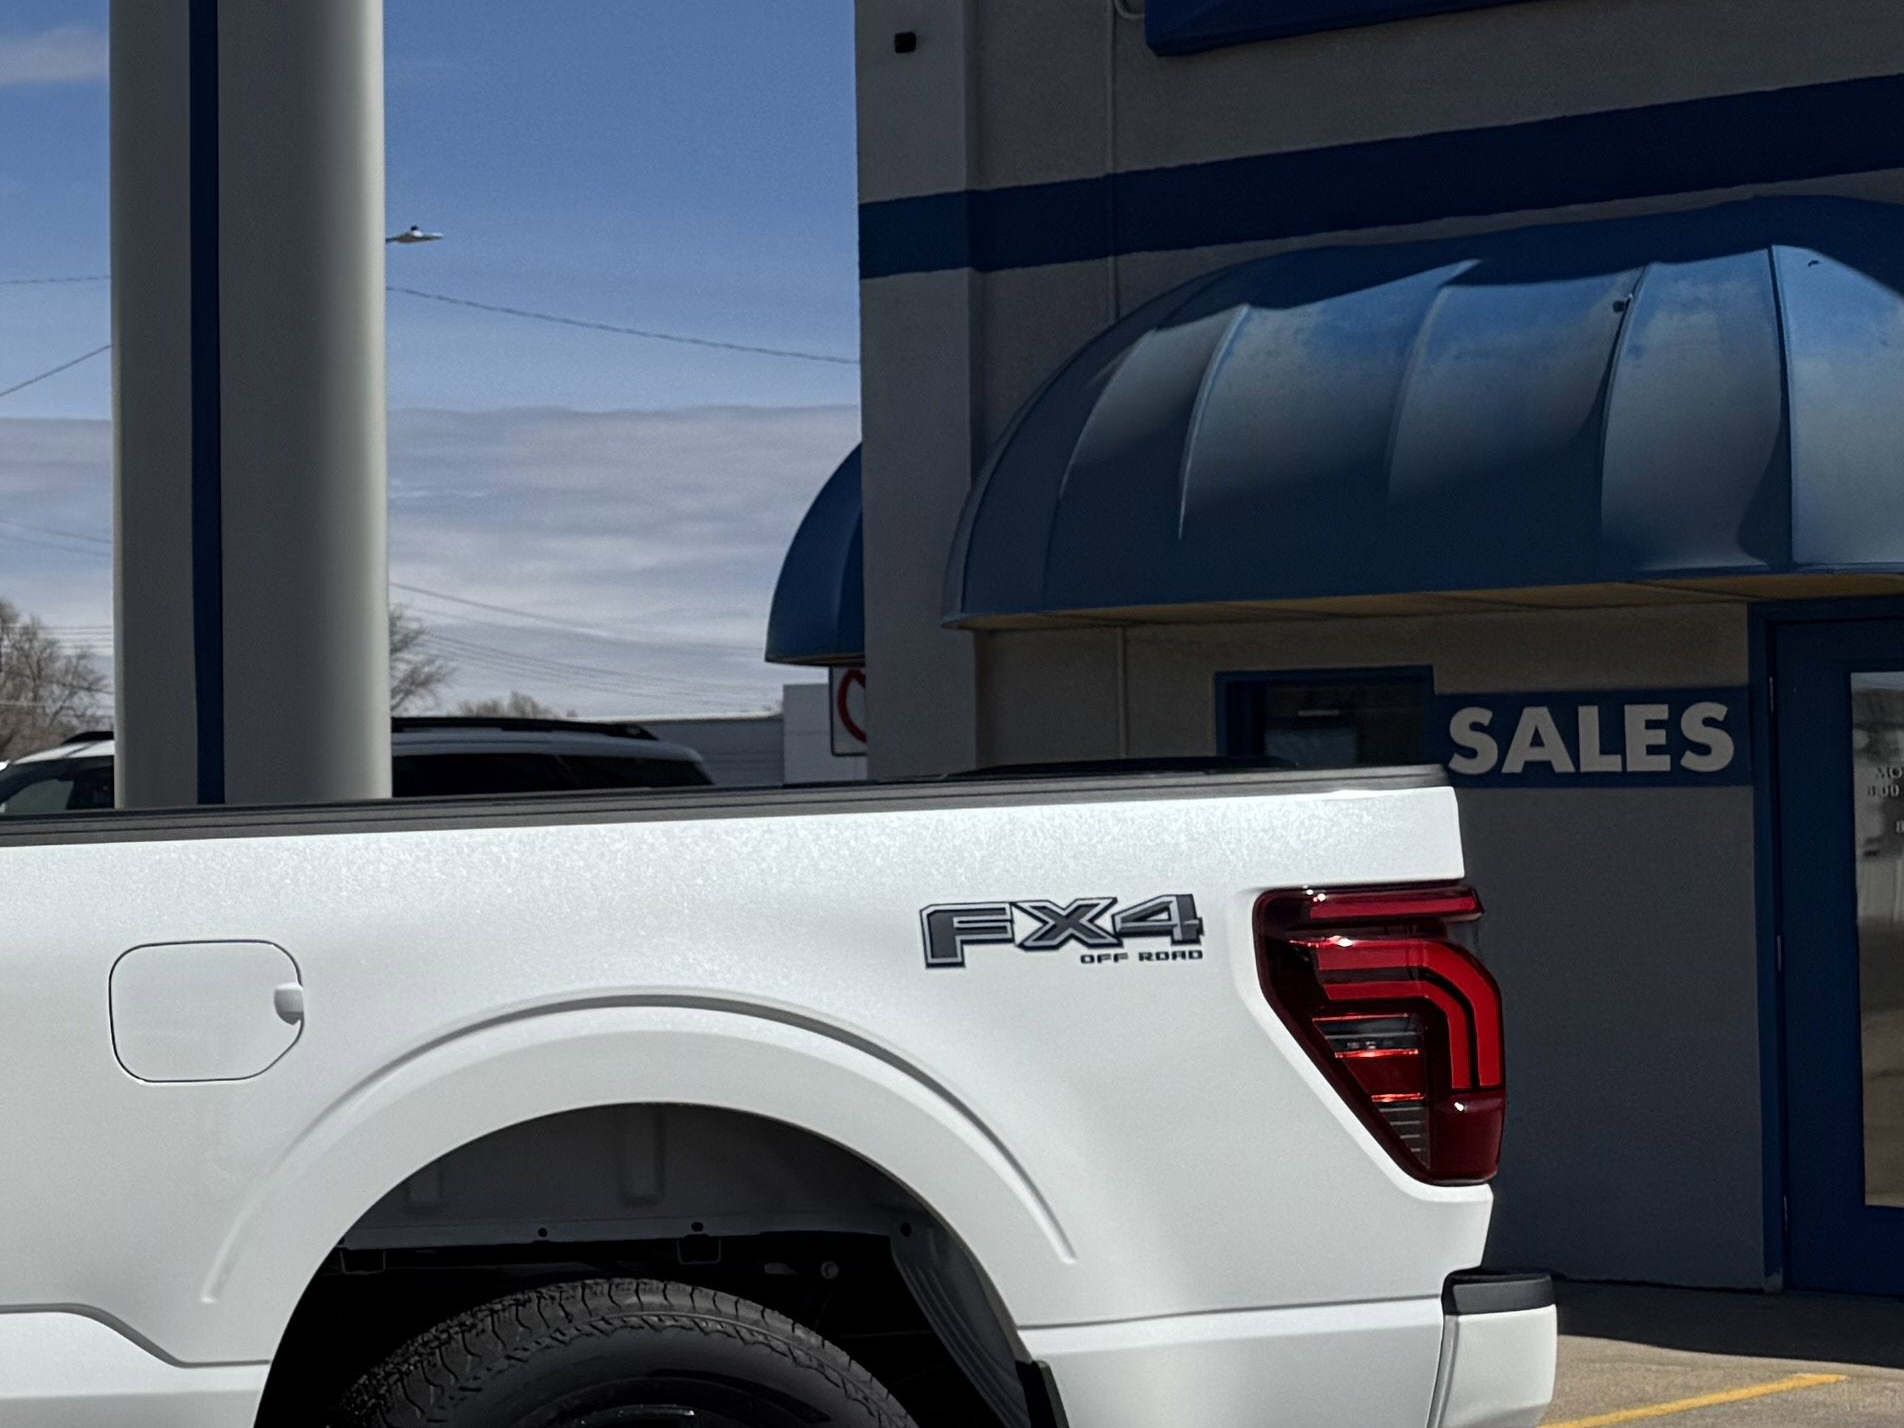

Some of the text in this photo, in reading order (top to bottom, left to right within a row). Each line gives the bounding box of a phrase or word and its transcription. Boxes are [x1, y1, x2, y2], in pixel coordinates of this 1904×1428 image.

[1447, 701, 1735, 774] SALES
[919, 893, 1205, 969] FX4
[1080, 950, 1204, 965] OFF ROAD
